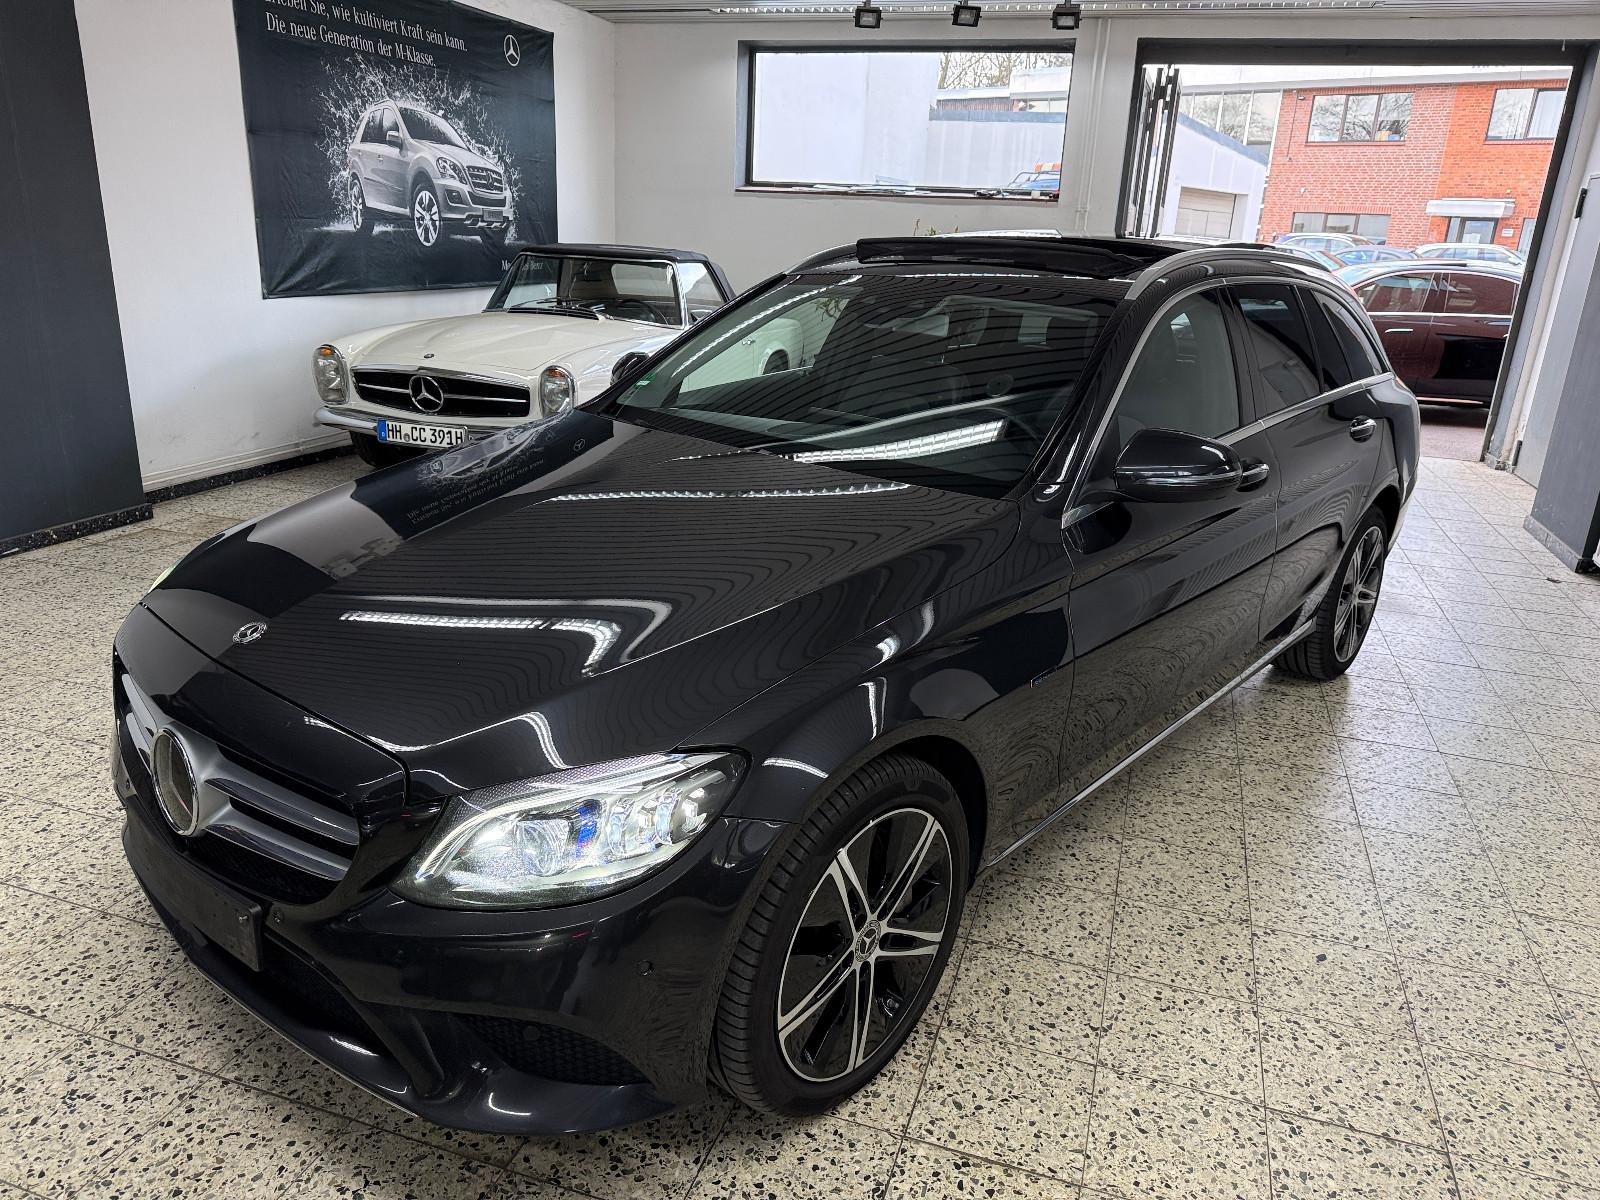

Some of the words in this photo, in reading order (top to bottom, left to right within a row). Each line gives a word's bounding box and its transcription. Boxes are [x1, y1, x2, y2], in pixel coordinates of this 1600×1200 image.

[265, 11, 287, 34] Die
[290, 22, 317, 40] neue
[320, 24, 375, 53] Generation
[377, 38, 392, 57] der
[395, 42, 437, 67] M-Klasse.
[310, 0, 330, 20] Sie,
[331, 3, 351, 22] wie
[353, 6, 398, 34] kultiviert
[400, 19, 424, 40] Kraft
[425, 28, 443, 46] sein
[444, 31, 468, 52] kann.
[387, 423, 402, 440] HH
[411, 426, 426, 442] CC
[429, 428, 463, 446] 391H
